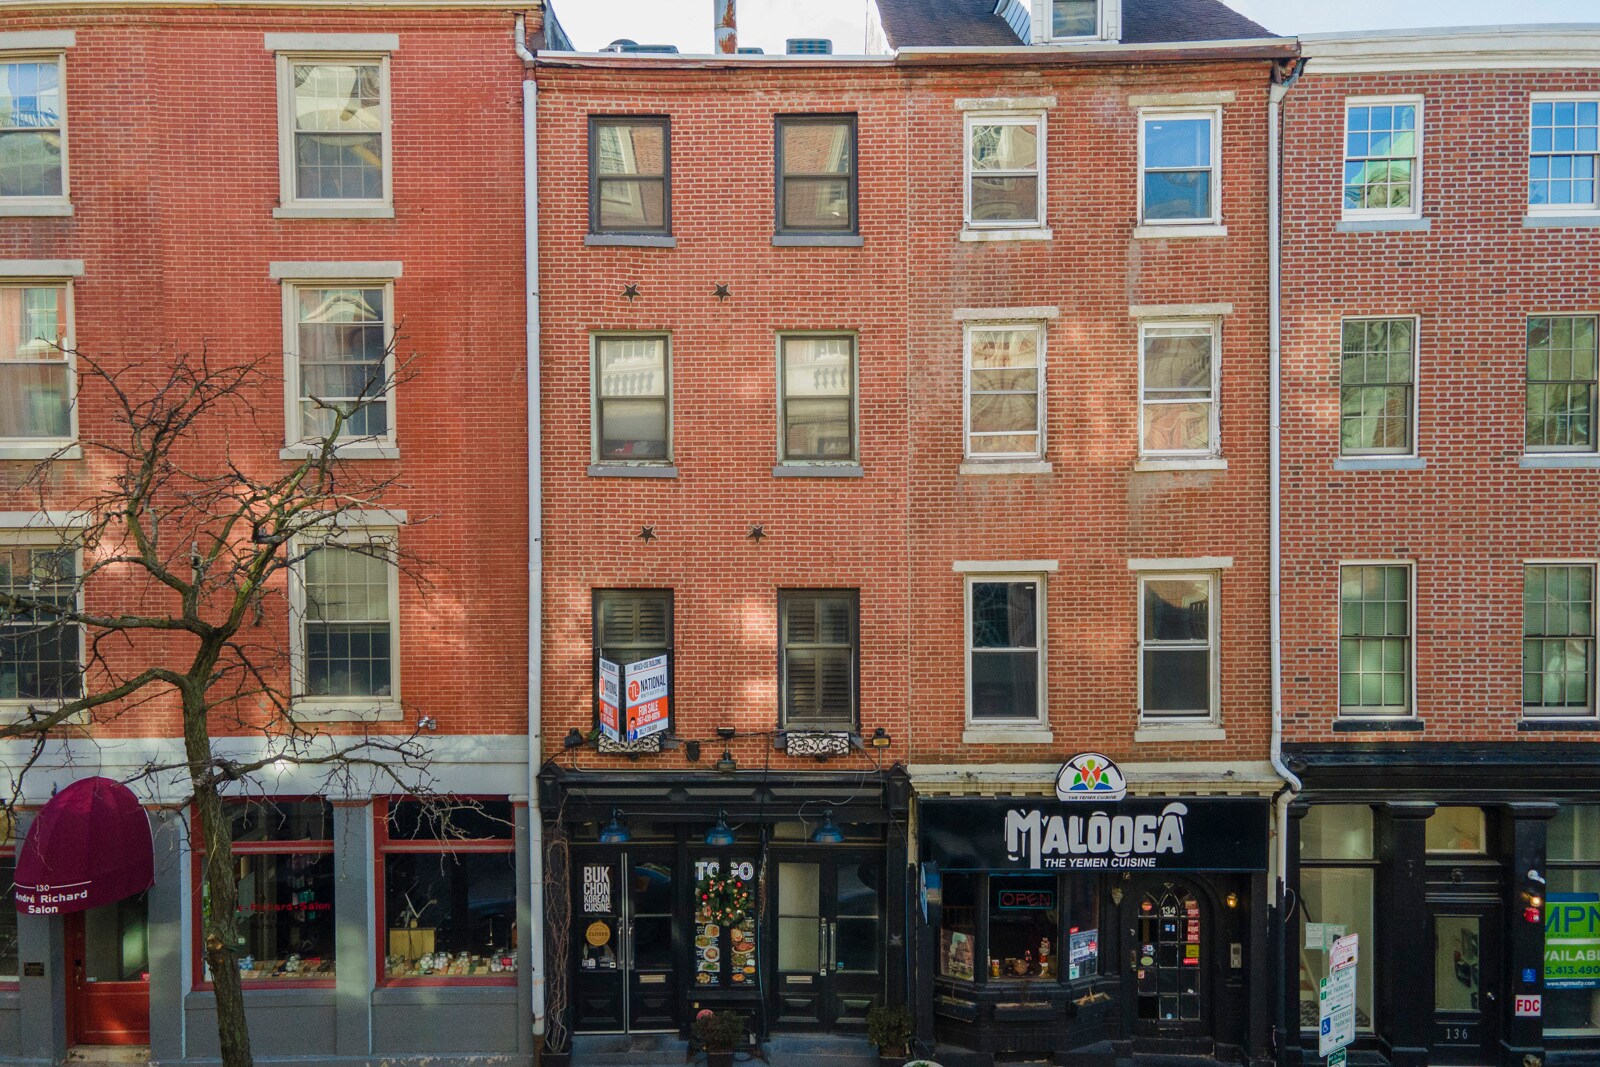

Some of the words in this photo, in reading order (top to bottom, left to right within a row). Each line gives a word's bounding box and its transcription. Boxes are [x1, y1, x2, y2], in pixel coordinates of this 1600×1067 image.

[641, 674, 666, 692] NATIONAL
[1044, 858, 1066, 868] THE
[1069, 858, 1108, 868] YEMEN
[1111, 858, 1156, 868] CUISINE
[583, 866, 610, 883] BUK
[695, 861, 720, 881] TO
[36, 884, 50, 892] 130
[583, 882, 610, 895] CHON
[40, 890, 88, 903] Richard
[583, 894, 610, 903] KOREAN
[1002, 892, 1051, 906] OPEN
[28, 905, 58, 914] Salon
[583, 903, 611, 912] CUISINE
[1161, 906, 1176, 915] 134
[1516, 999, 1540, 1012] FDC
[1446, 1028, 1468, 1040] 136
